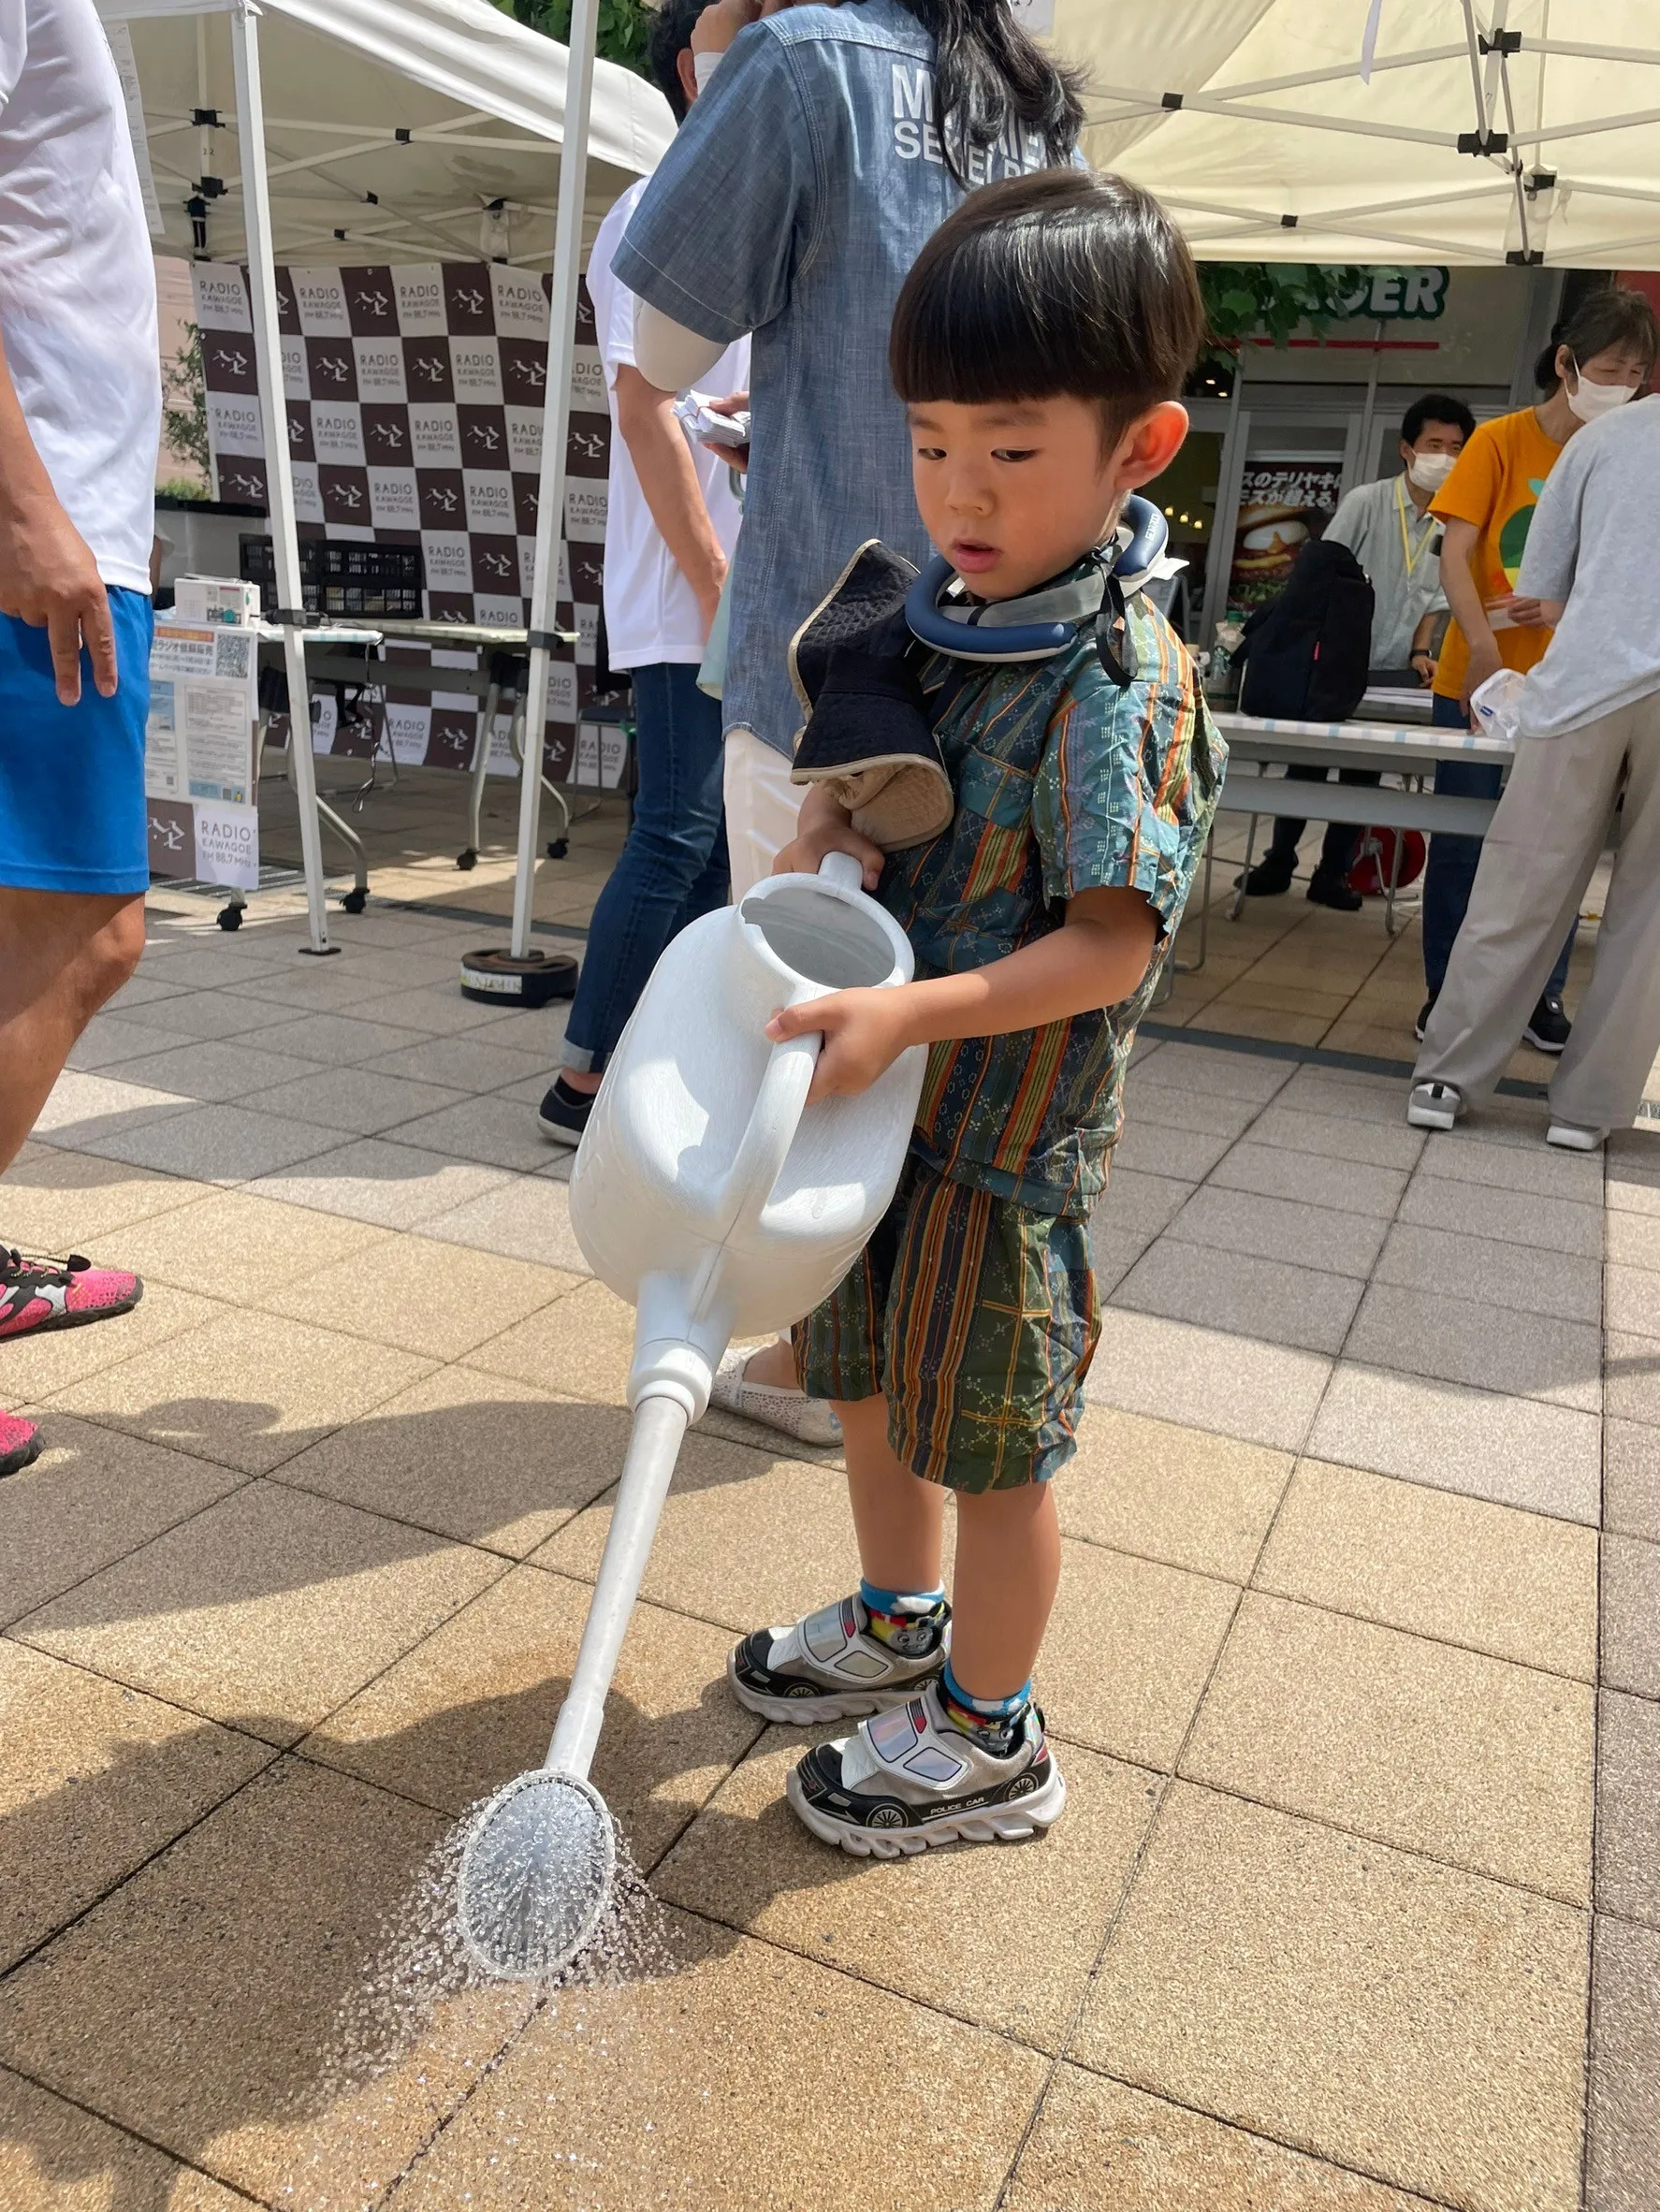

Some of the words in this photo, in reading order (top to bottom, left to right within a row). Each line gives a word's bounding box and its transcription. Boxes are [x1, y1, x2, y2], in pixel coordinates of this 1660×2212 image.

[199, 281, 240, 296] RADIO
[299, 287, 340, 299] RADIO
[400, 284, 439, 298] RADIO
[498, 284, 542, 302] RADIO
[360, 355, 399, 366] RADIO
[456, 354, 494, 366] RADIO
[572, 362, 604, 376] DIO
[215, 408, 255, 422] RADIO
[316, 417, 357, 429] RADIO
[415, 420, 453, 431] RADIO
[512, 423, 543, 436] RADI
[375, 483, 413, 495] RADIO
[470, 486, 508, 499] RADIO
[569, 493, 608, 506] RADIO
[429, 546, 465, 558] RADIO
[480, 609, 518, 623] RADIO
[548, 677, 572, 689] DIO
[201, 820, 252, 842] RADIO
[930, 1802, 962, 1815] POLICE
[966, 1797, 985, 1807] CAR
